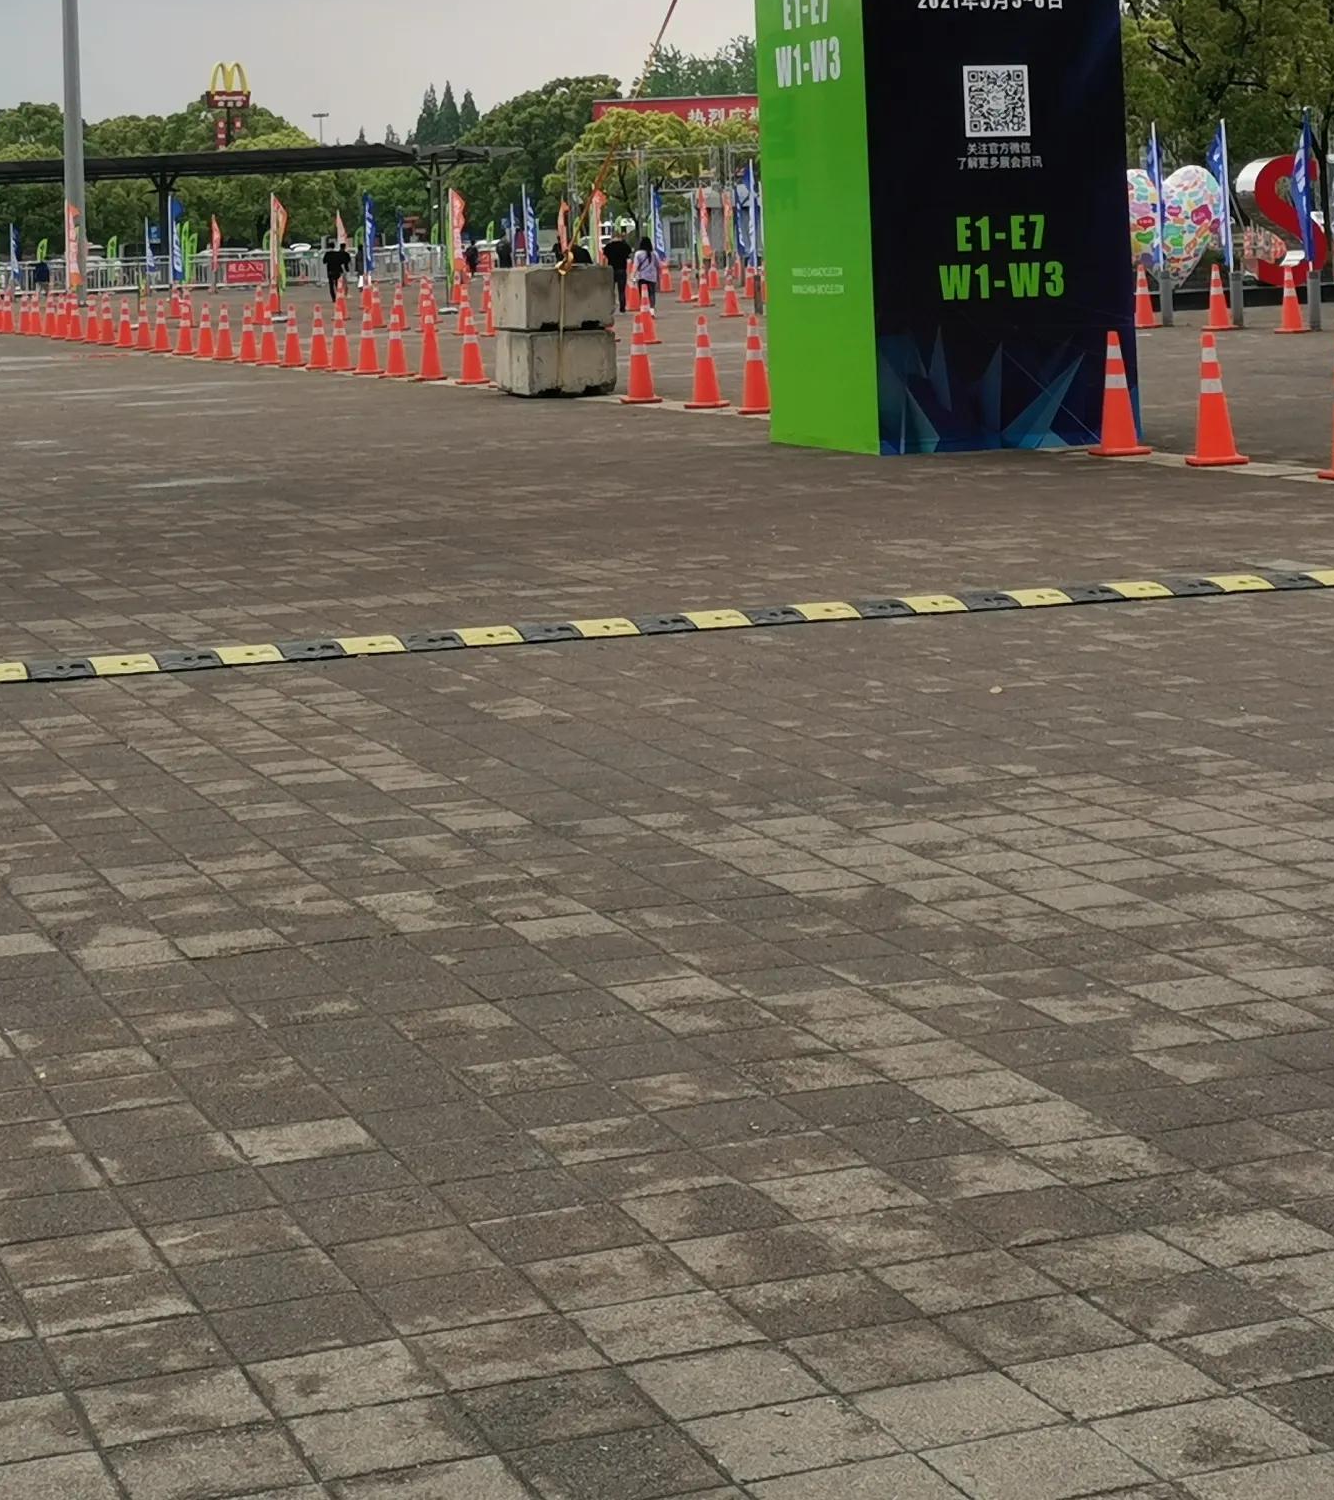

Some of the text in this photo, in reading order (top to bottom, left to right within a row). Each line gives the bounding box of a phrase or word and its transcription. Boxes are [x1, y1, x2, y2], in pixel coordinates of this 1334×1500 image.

[774, 35, 842, 89] W1-W3
[955, 213, 1046, 253] E1-E7
[938, 260, 1066, 301] W1-W3
